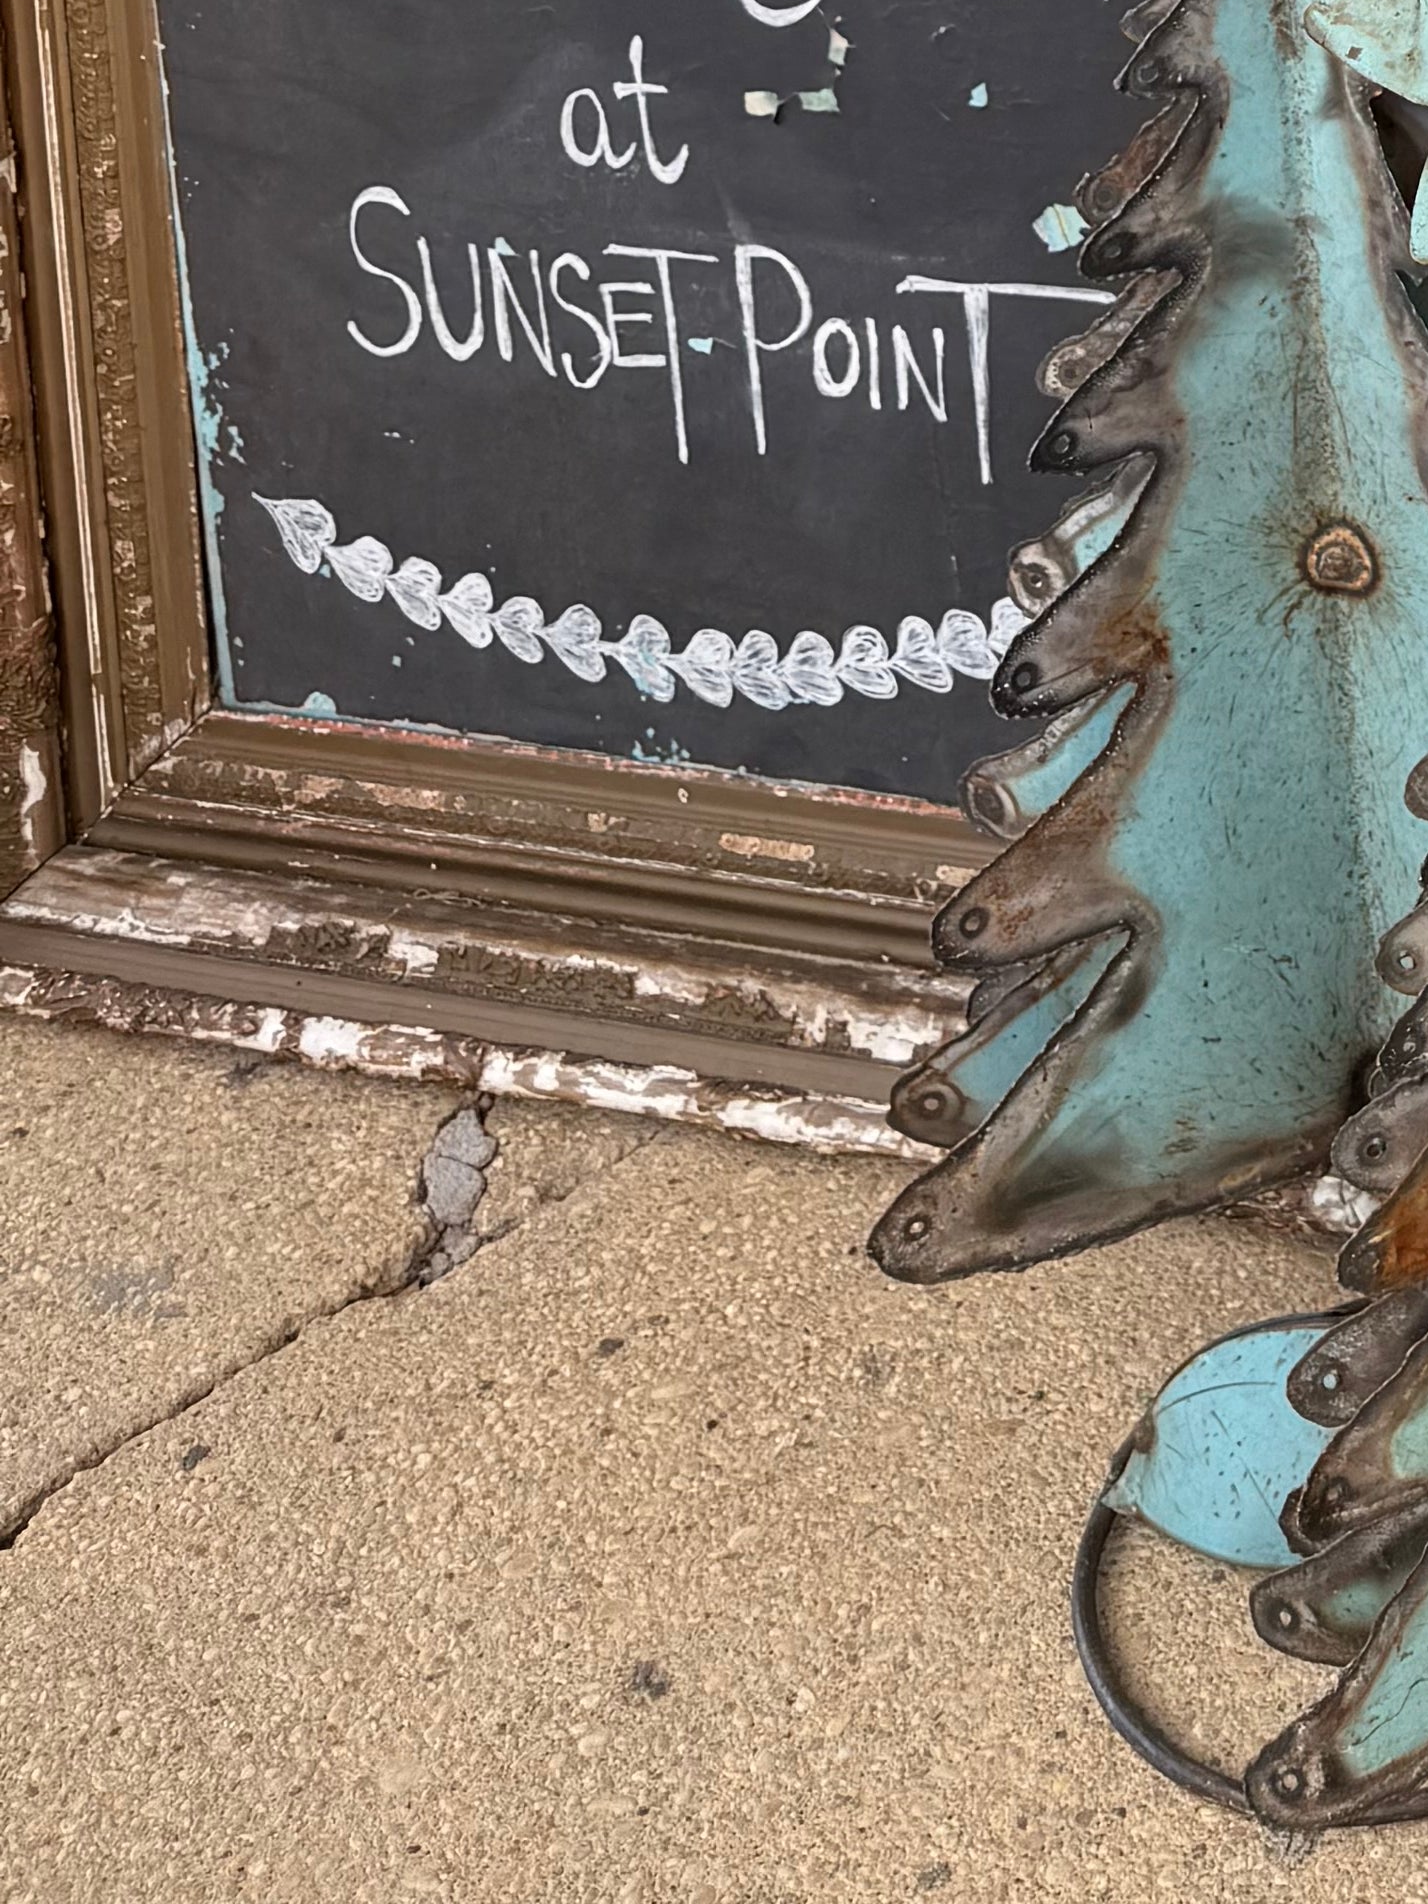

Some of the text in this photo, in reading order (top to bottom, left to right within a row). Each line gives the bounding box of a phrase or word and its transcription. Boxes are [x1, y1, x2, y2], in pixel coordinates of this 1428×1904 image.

[559, 33, 690, 186] at
[346, 184, 1118, 485] SUNSET POINT
